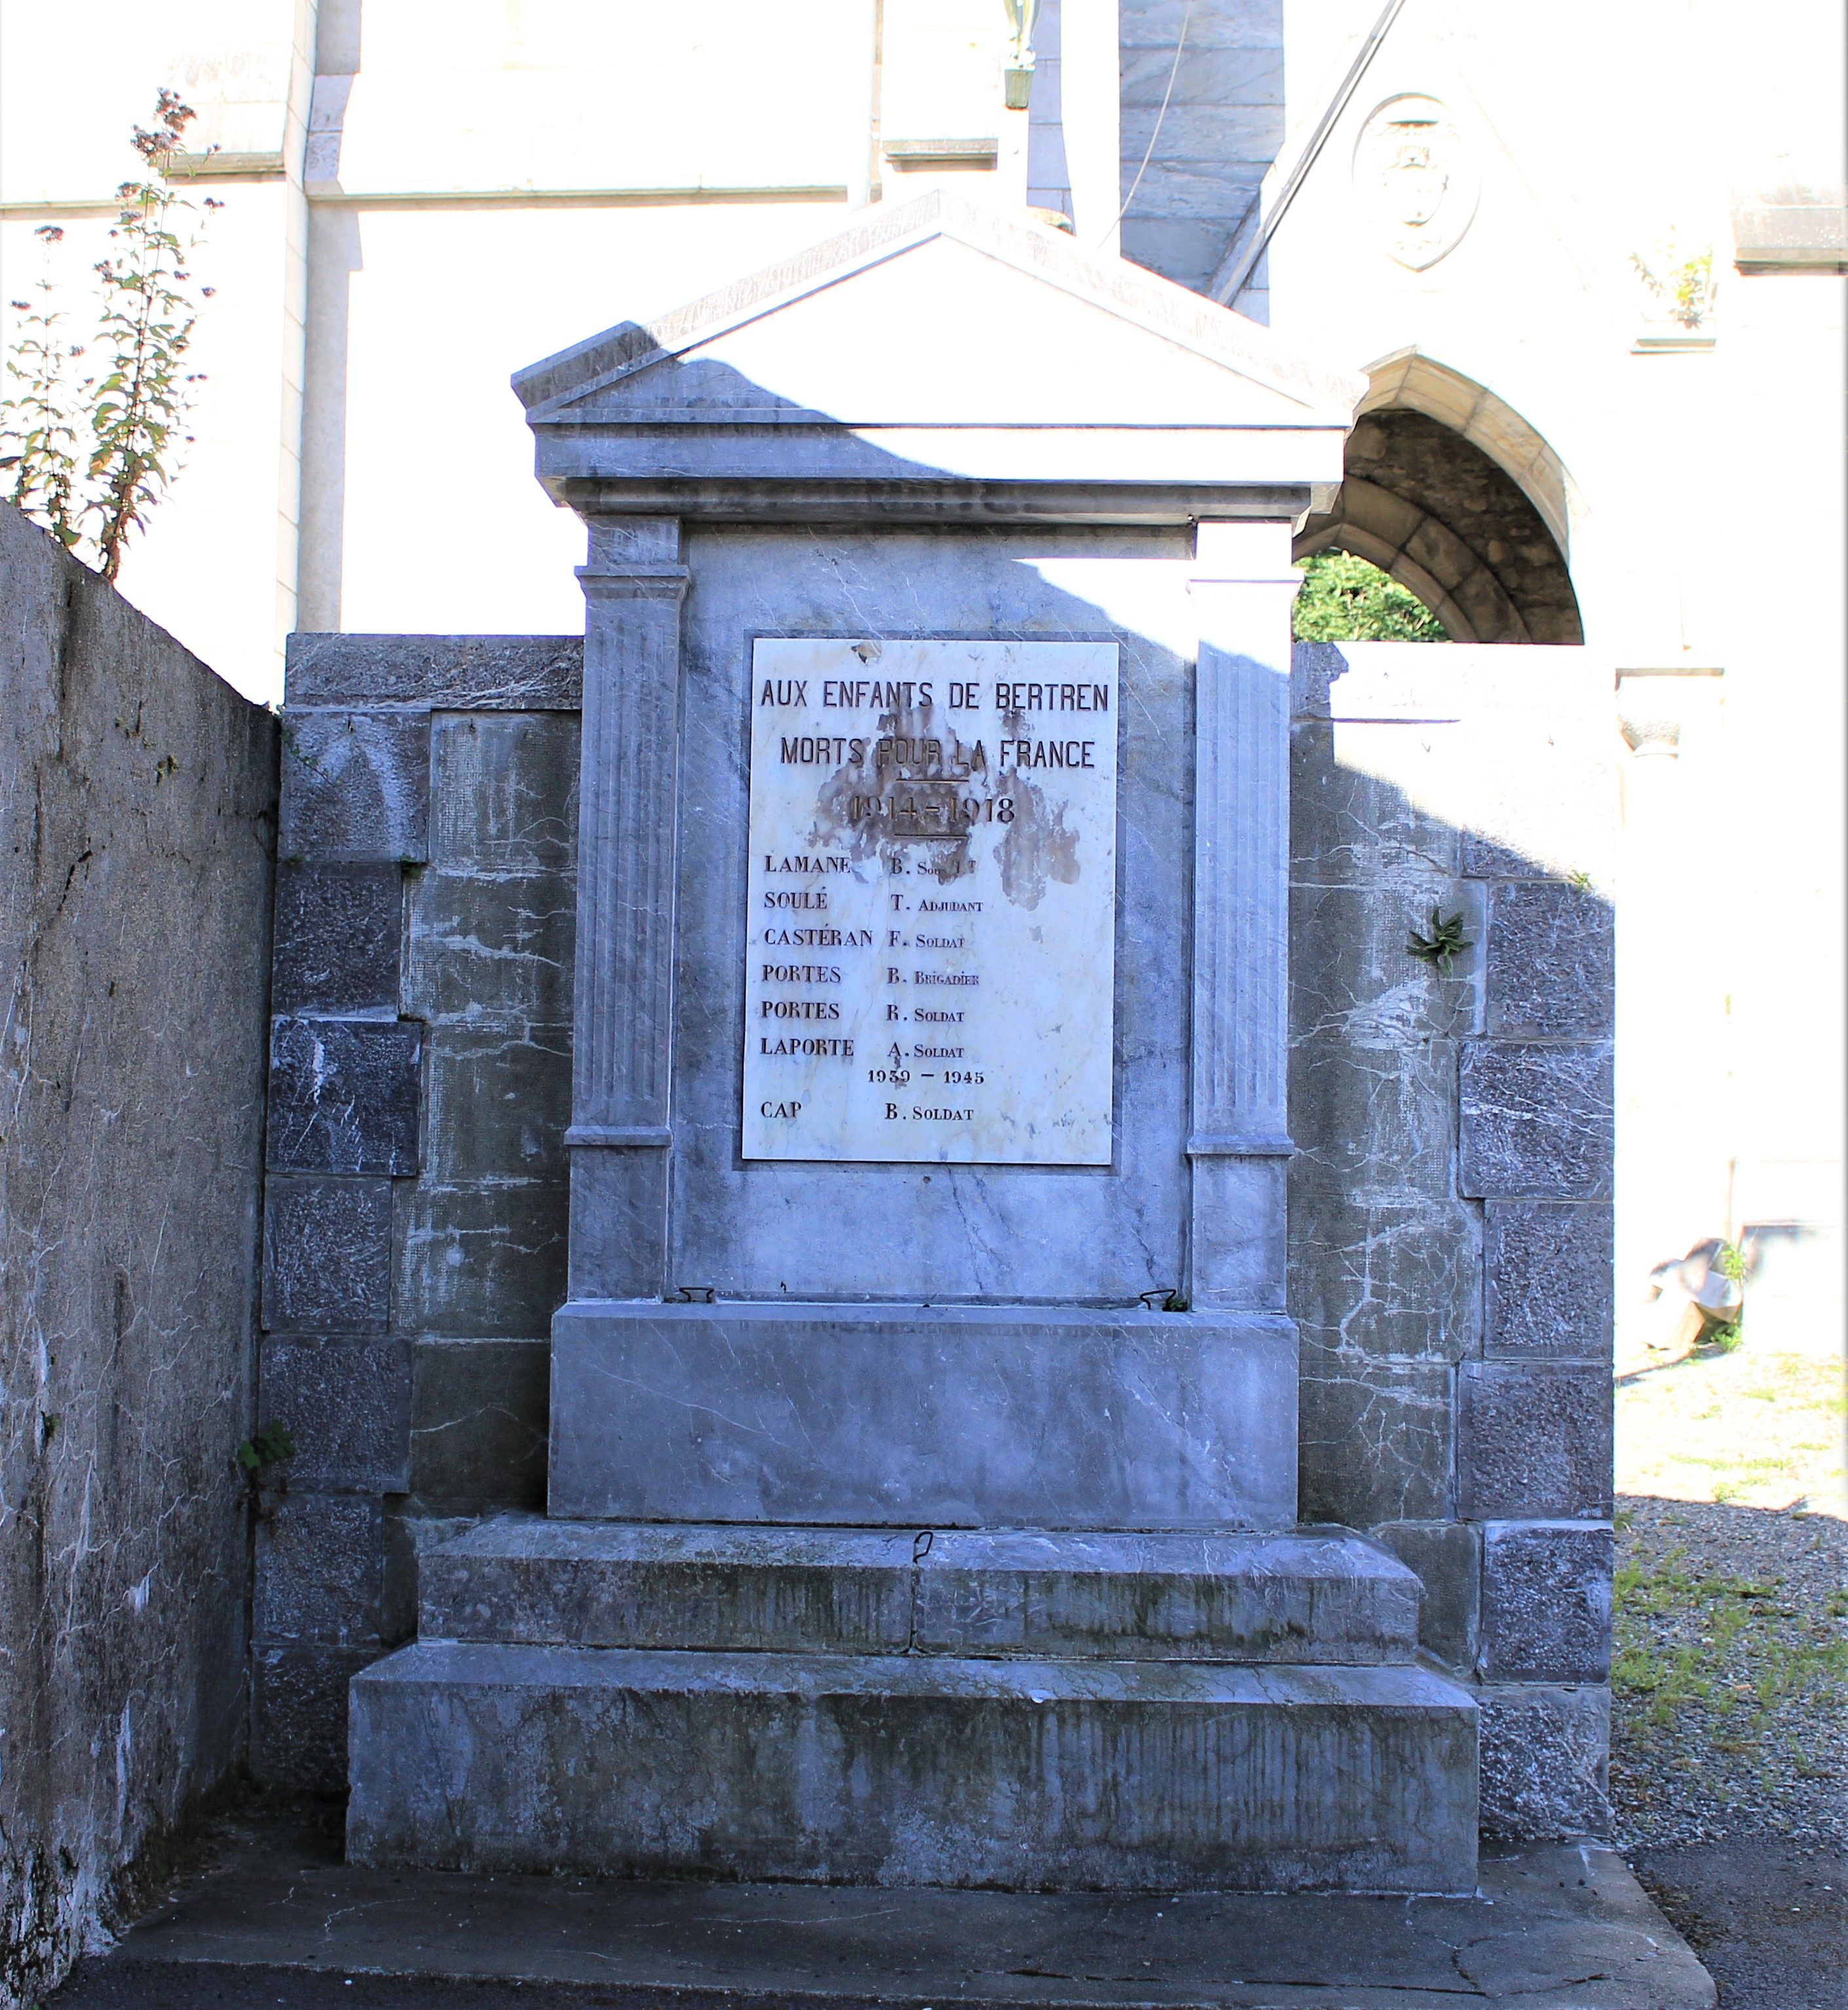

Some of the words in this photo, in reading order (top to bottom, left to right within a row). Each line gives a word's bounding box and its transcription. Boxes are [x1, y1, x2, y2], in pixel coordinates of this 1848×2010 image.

[761, 680, 808, 708] AUX
[823, 681, 933, 708] ENFANTS
[949, 683, 980, 709] DE
[996, 683, 1109, 711] BERTREN
[780, 737, 863, 764] MORTS
[878, 738, 941, 767] POUR
[954, 740, 987, 768] LA
[1000, 740, 1096, 768] FRANCE
[765, 856, 850, 873] LAMANE
[891, 858, 911, 875] B.
[764, 886, 827, 909] SOULÉ
[890, 894, 911, 911] T.
[918, 900, 984, 912] ADJUDANT
[764, 923, 873, 946] CASTÉRAN
[888, 930, 909, 947] F.
[916, 934, 966, 948] SOLDAT
[762, 965, 841, 983] PORTES
[887, 968, 907, 984] B.
[761, 1002, 839, 1020] PORTES
[886, 1005, 908, 1021] R.
[915, 1008, 964, 1023] SOLDAT
[760, 1038, 854, 1057] LAPORTE
[888, 1042, 909, 1058] A.
[914, 1044, 964, 1058] SOLDAT
[761, 1102, 802, 1118] CAP
[885, 1103, 906, 1120] B.
[913, 1106, 973, 1120] SOLDAT
